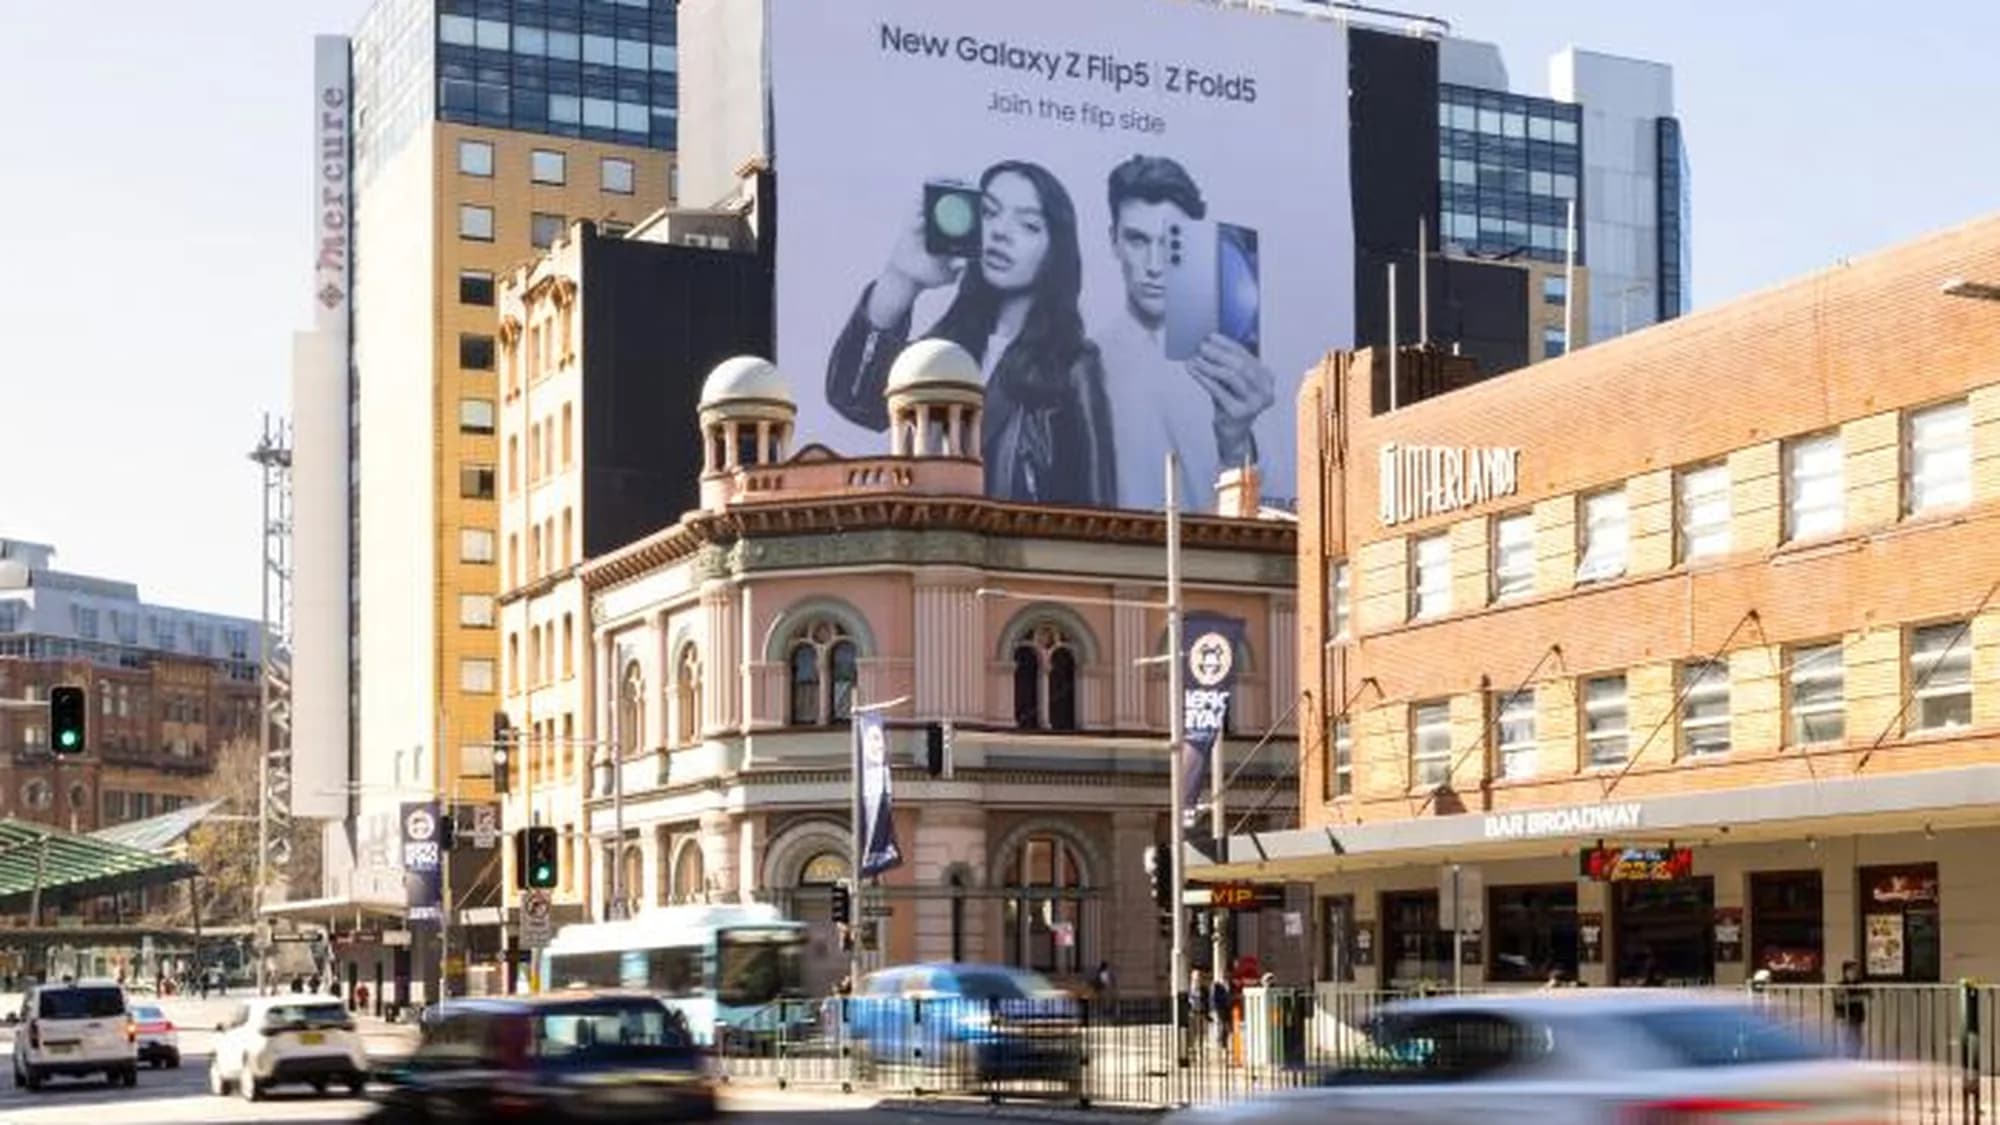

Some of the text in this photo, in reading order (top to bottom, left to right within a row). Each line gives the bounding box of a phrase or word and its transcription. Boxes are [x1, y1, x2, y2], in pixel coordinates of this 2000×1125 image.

[881, 24, 1257, 103] New Galaxy Z Flip5 Z Fold5
[987, 92, 1167, 134] Join the flip side
[1484, 804, 1641, 837] BAR BROADWAY
[1212, 889, 1253, 904] VIP
